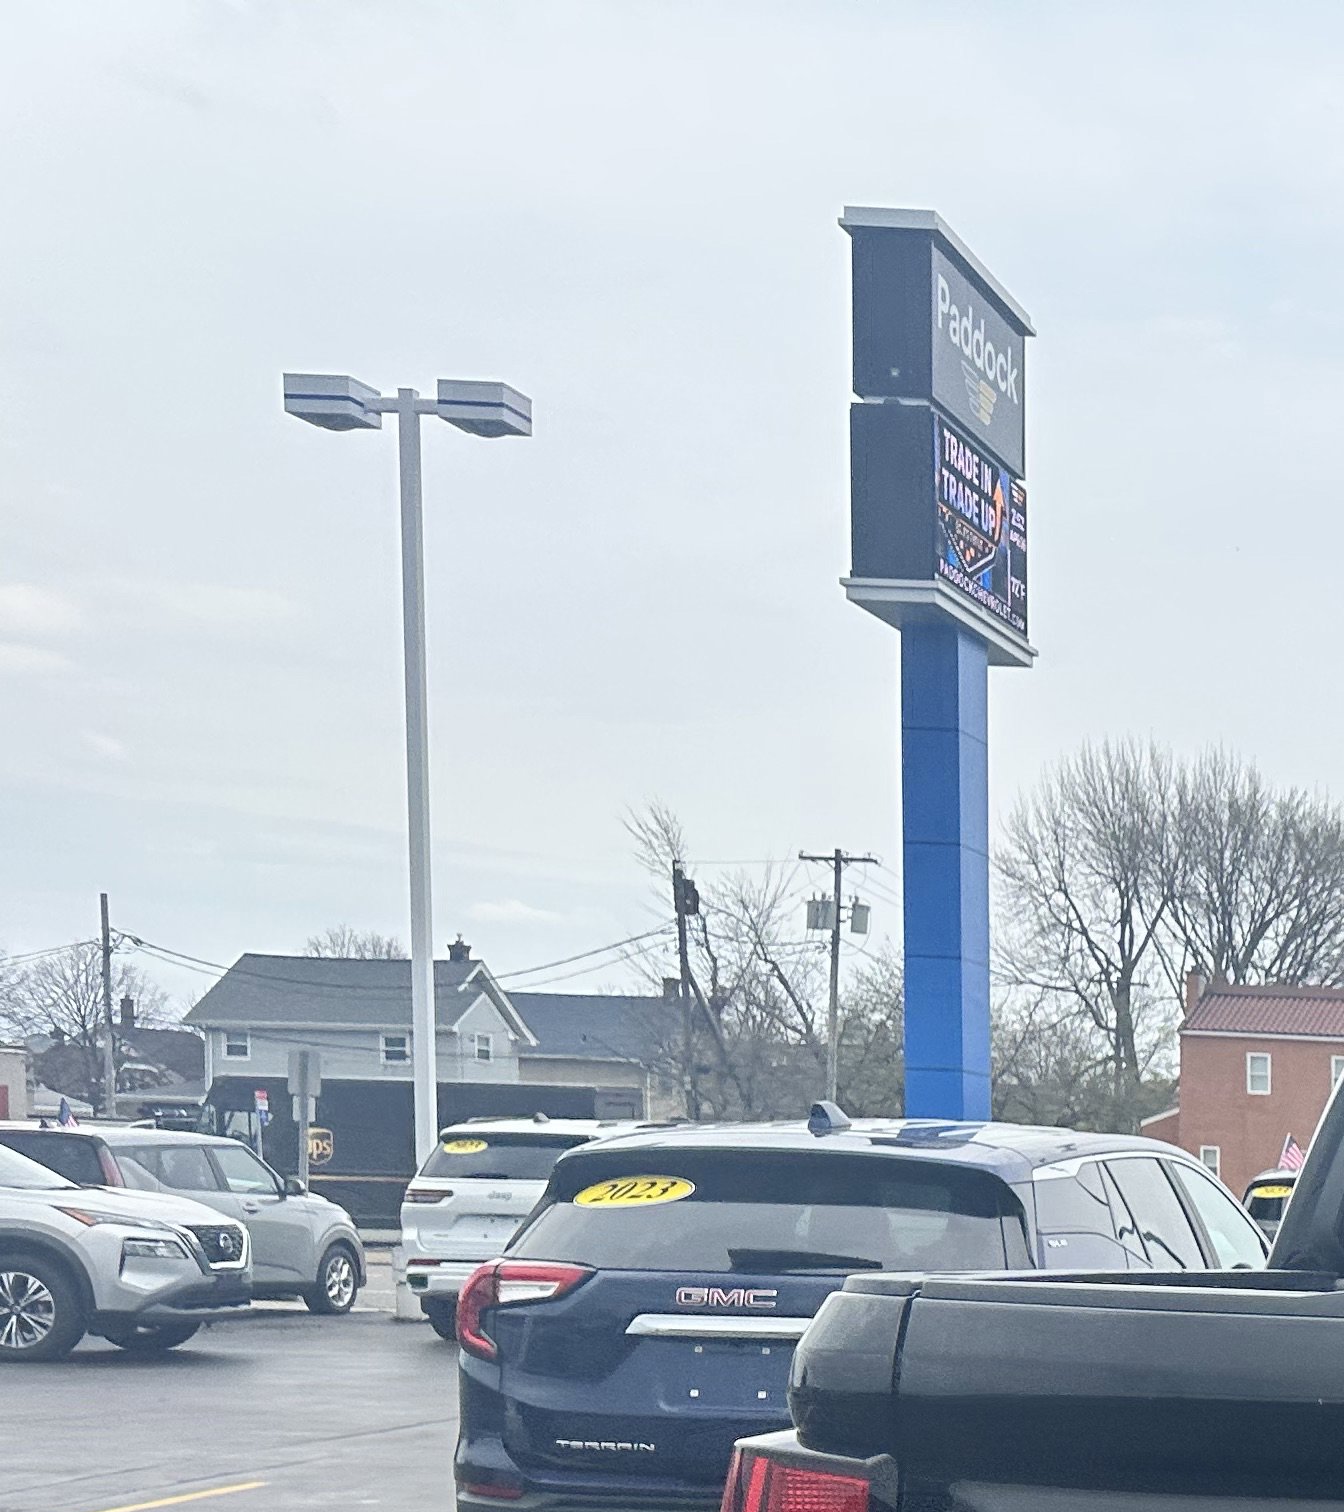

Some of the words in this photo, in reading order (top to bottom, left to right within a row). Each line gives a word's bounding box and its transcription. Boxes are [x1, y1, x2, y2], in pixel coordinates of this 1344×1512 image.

[937, 273, 1018, 405] Paddock
[943, 428, 980, 487] TRADE
[980, 460, 992, 497] IN
[941, 467, 980, 527] TRADE
[981, 498, 996, 537] UP
[588, 1181, 678, 1202] 2023
[675, 1287, 778, 1309] GMC
[555, 1439, 656, 1452] TERRAIN
